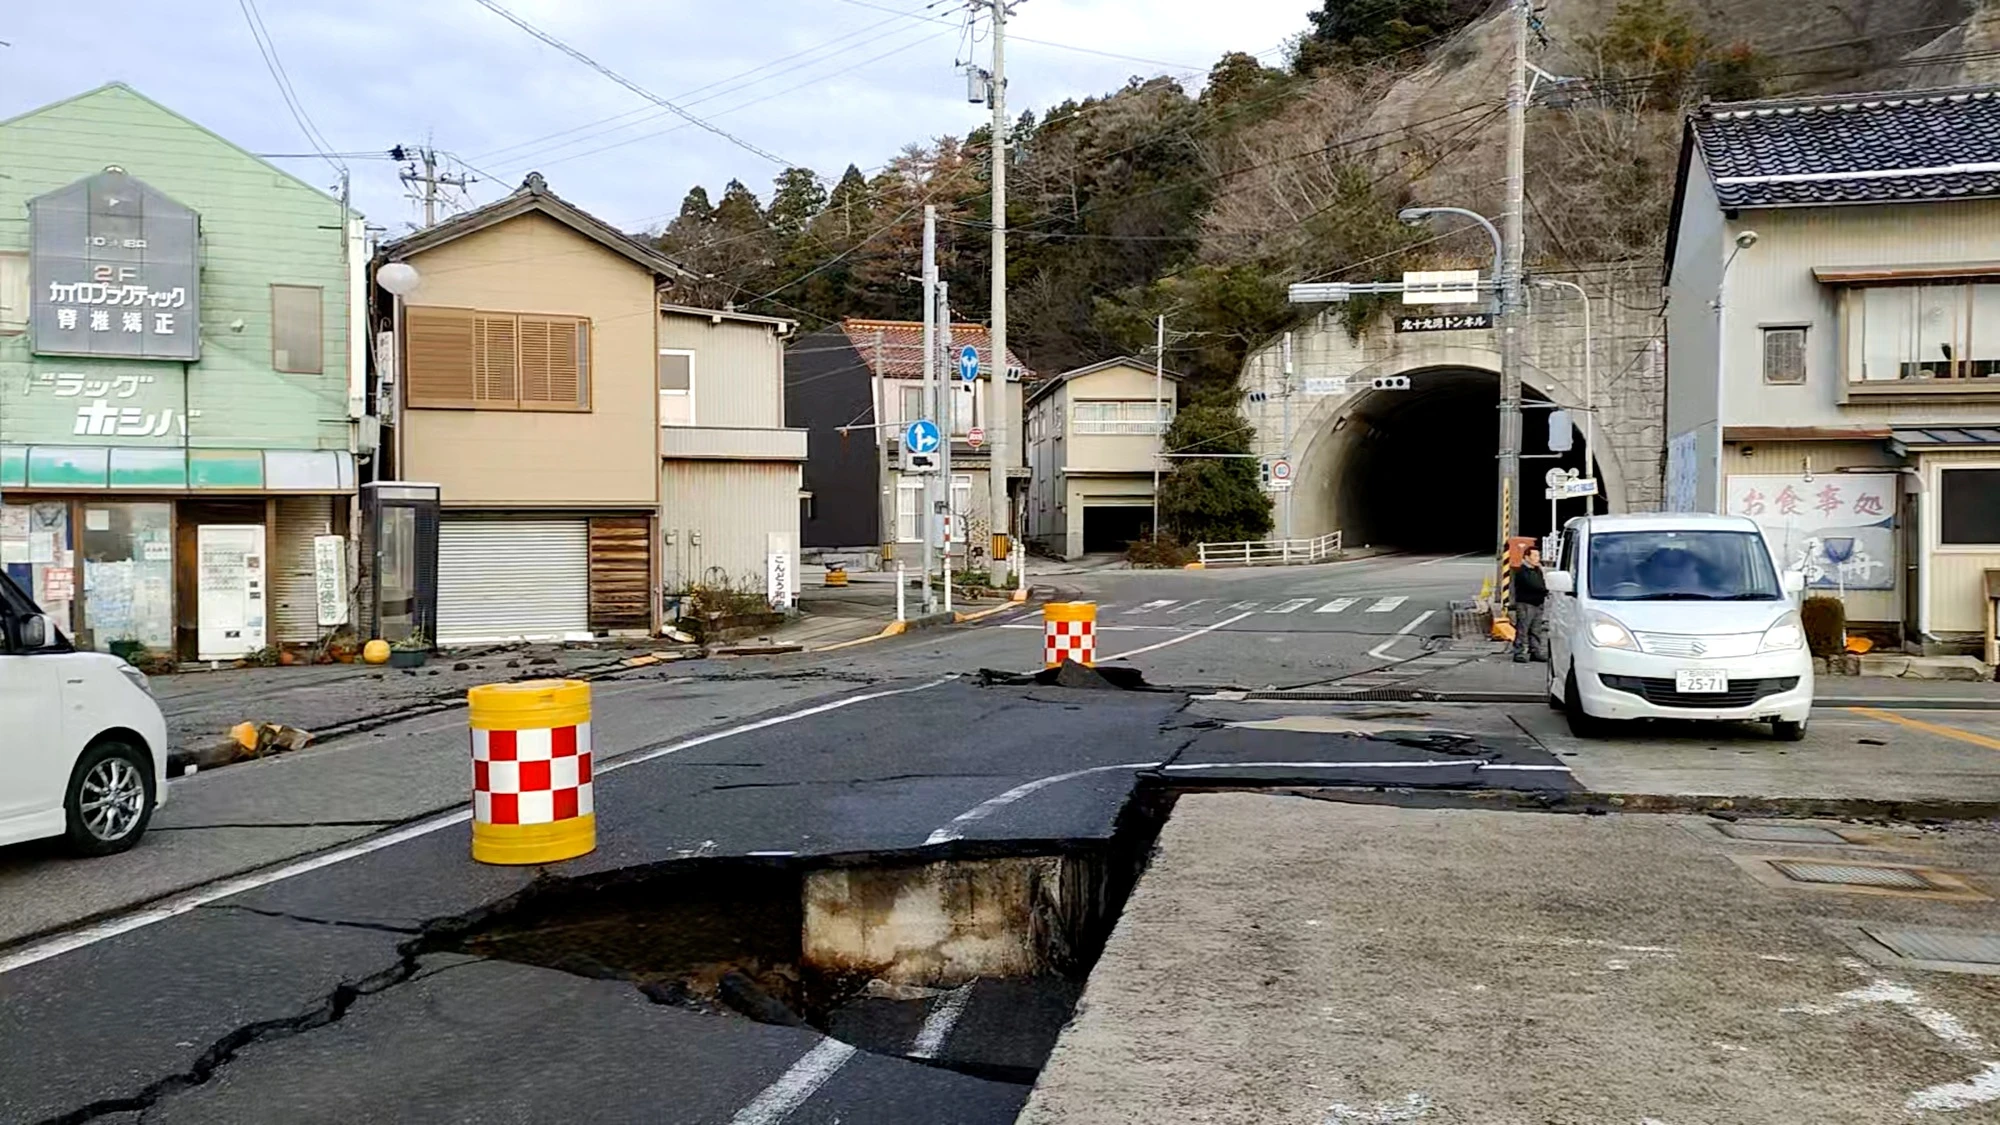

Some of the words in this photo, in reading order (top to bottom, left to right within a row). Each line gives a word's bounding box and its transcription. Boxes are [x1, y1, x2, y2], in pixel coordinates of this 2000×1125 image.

[50, 281, 185, 307] カイロプラクティック
[57, 309, 175, 334] 脊椎矯正
[24, 372, 154, 398] ドラッグ
[1742, 484, 1884, 517] お食事処
[1688, 679, 1723, 690] 25-71
